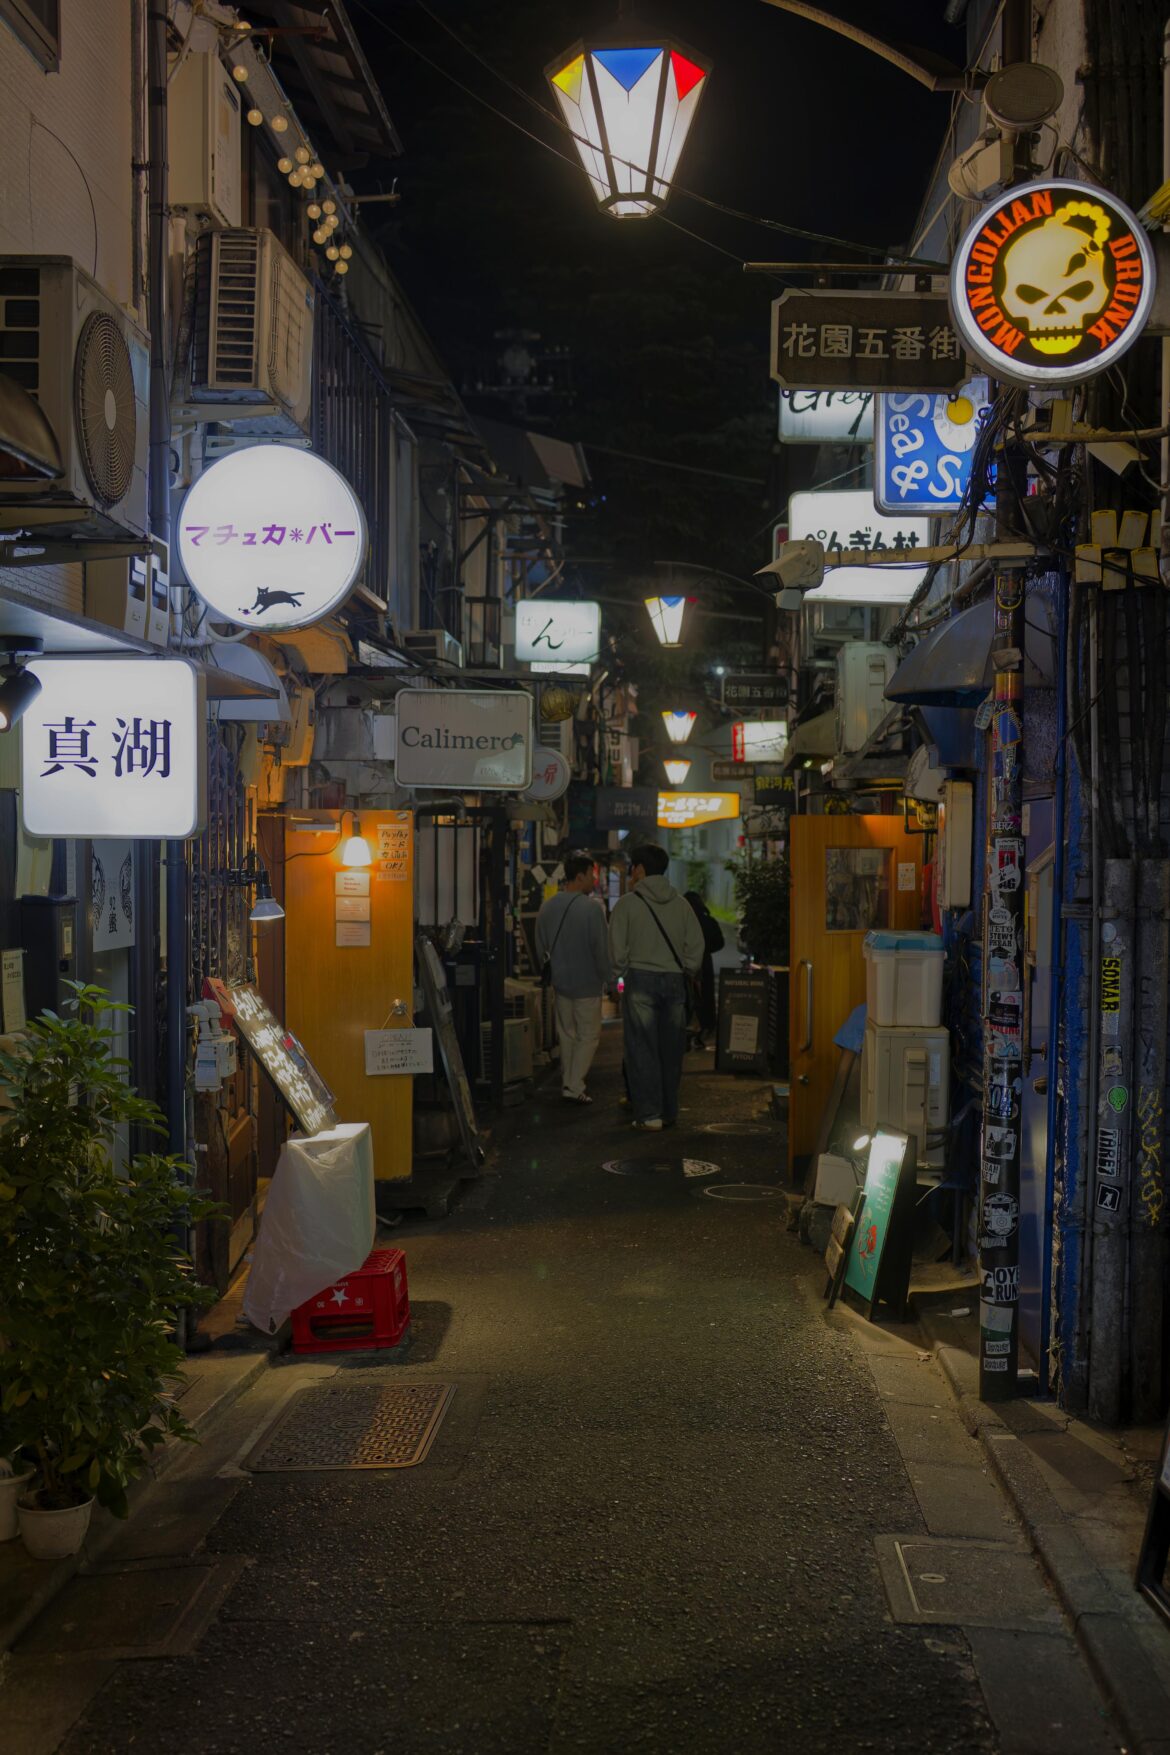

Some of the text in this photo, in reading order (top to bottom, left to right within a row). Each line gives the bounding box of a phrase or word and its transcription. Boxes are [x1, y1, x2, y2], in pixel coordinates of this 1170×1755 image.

[968, 190, 1142, 355] MONGOLIAN DRUNK
[783, 322, 961, 360] 花園五番街
[40, 716, 172, 778] 真湖
[401, 726, 514, 751] Calimero
[1102, 959, 1120, 1012] SONAR
